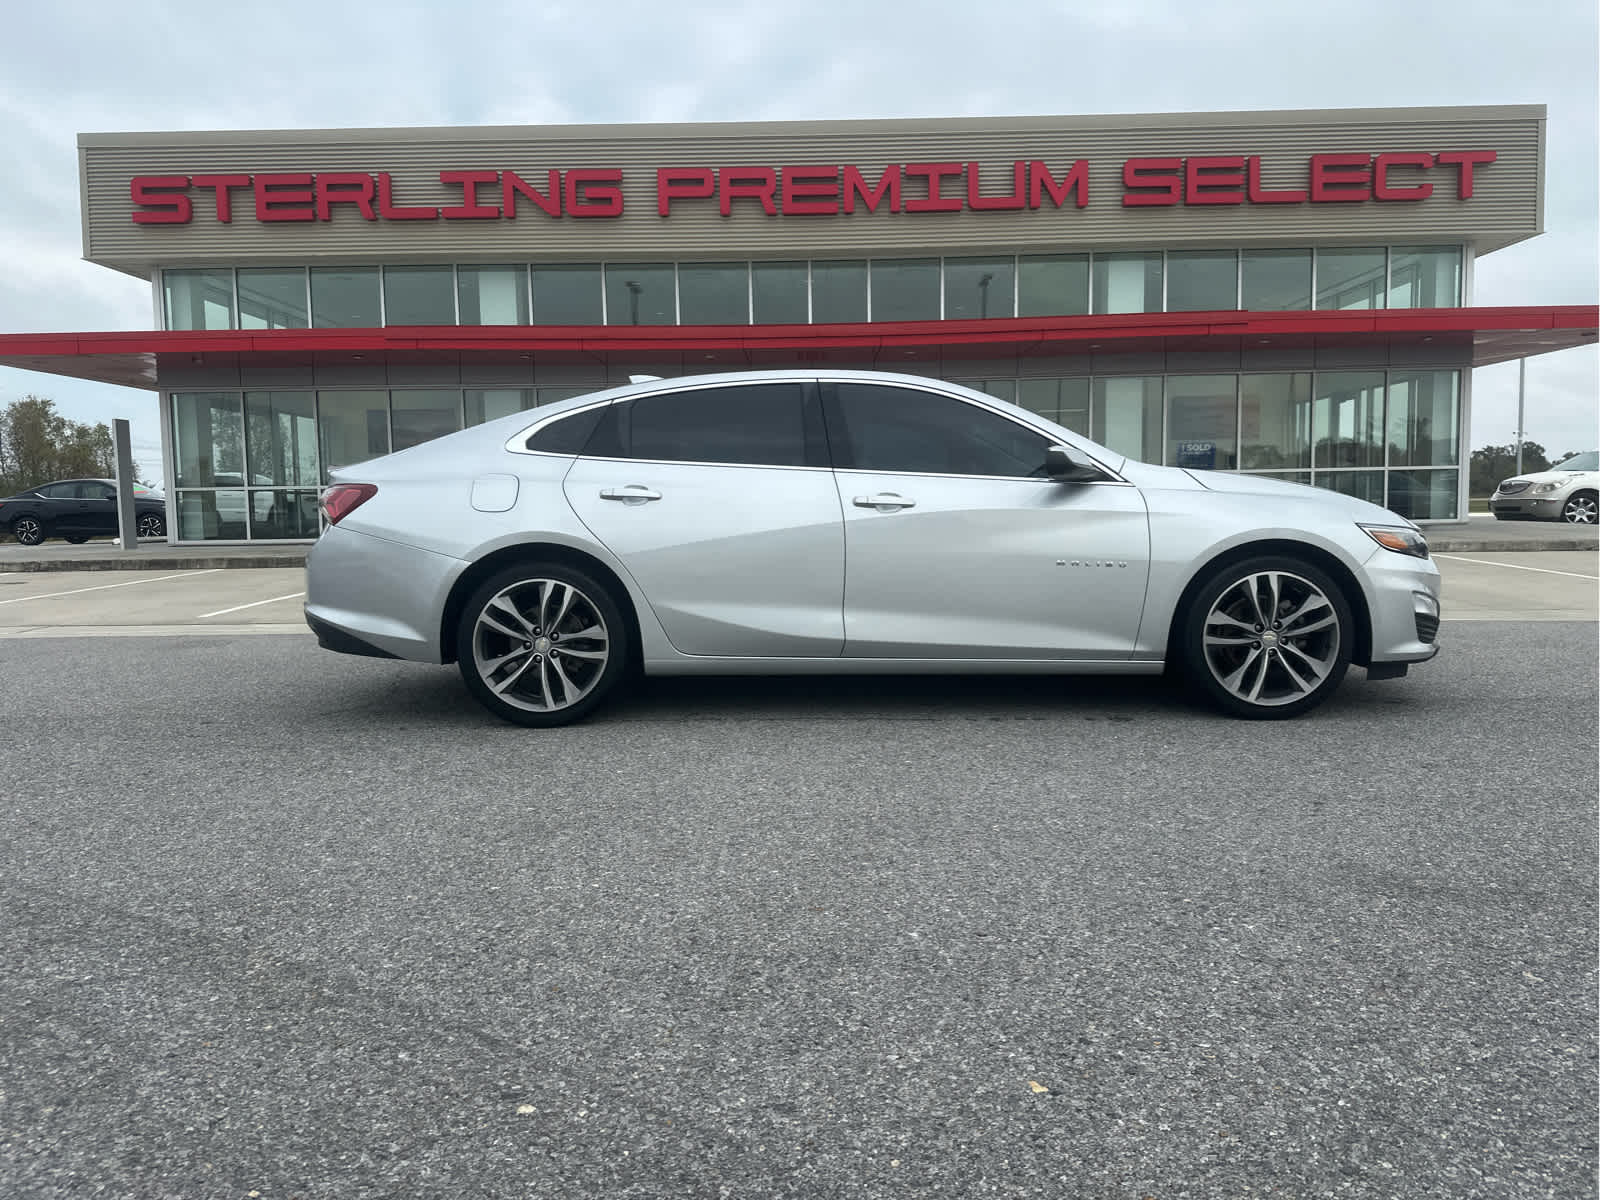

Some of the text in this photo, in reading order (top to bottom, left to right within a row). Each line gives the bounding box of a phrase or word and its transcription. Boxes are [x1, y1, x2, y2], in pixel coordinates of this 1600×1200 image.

[131, 151, 1497, 223] STERLING PREMIUM SELECT
[1186, 443, 1211, 452] SOLD
[1056, 559, 1128, 568] MALIBU
